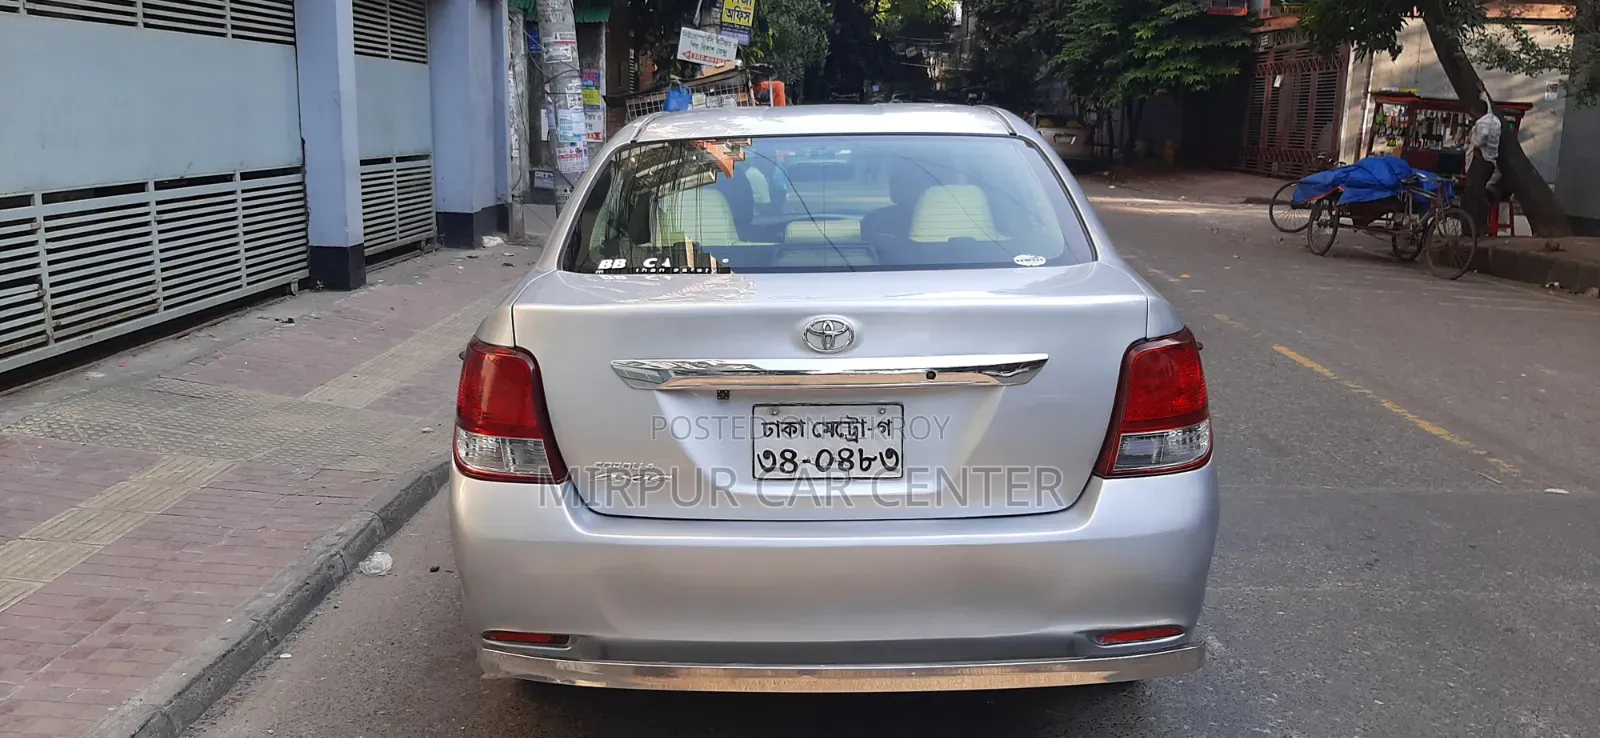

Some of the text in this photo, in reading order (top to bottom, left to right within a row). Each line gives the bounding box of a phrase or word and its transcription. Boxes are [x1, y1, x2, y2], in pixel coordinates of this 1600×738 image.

[725, 6, 752, 24] অফিস
[598, 259, 627, 269] BB
[761, 418, 806, 438] ঢাকা
[757, 448, 900, 474] ৩৪-০৪৮৩
